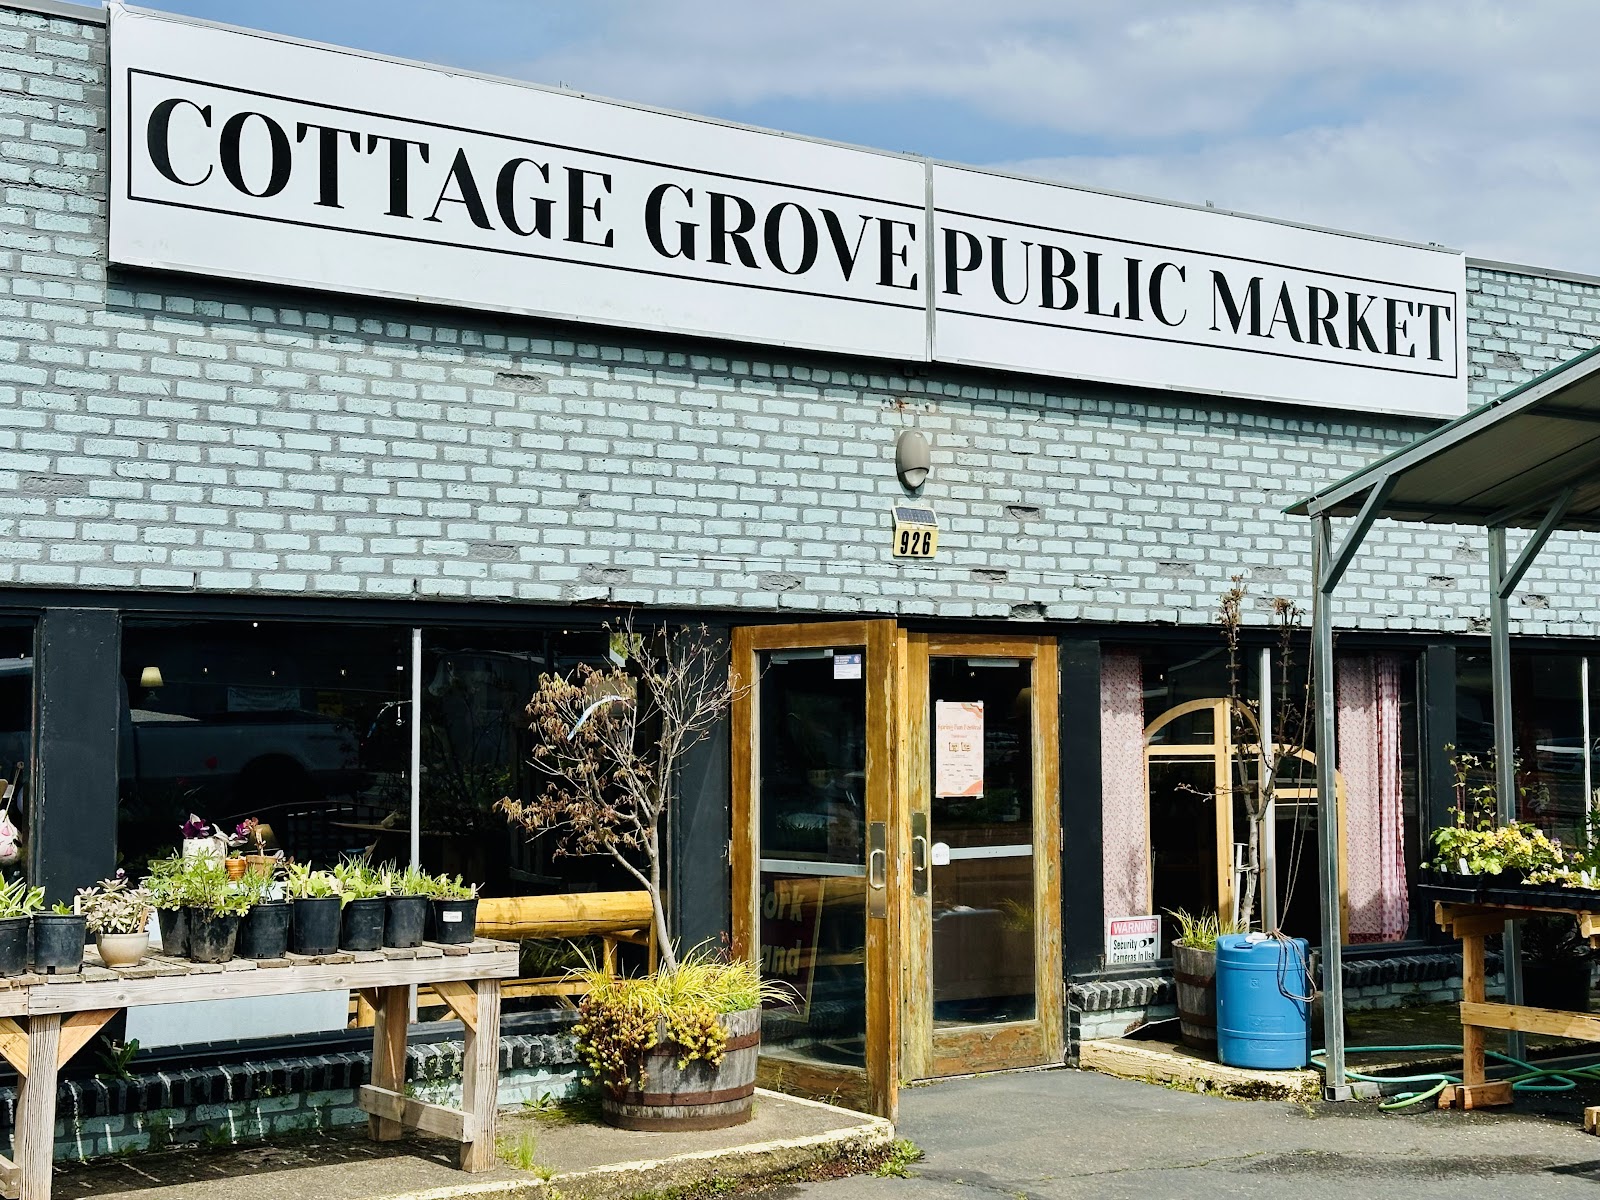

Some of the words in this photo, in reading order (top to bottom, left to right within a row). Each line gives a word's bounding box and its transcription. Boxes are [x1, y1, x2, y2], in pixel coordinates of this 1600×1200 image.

[146, 98, 614, 249] COTTAGE
[644, 183, 918, 291] GROVE
[940, 227, 1187, 327] PUBLIC
[1208, 269, 1451, 362] MARKET
[900, 530, 931, 555] 926
[1113, 920, 1157, 934] WARNING
[1113, 939, 1137, 950] Security
[1113, 953, 1136, 962] Cameras
[1138, 951, 1144, 961] In
[1145, 951, 1155, 960] Use
